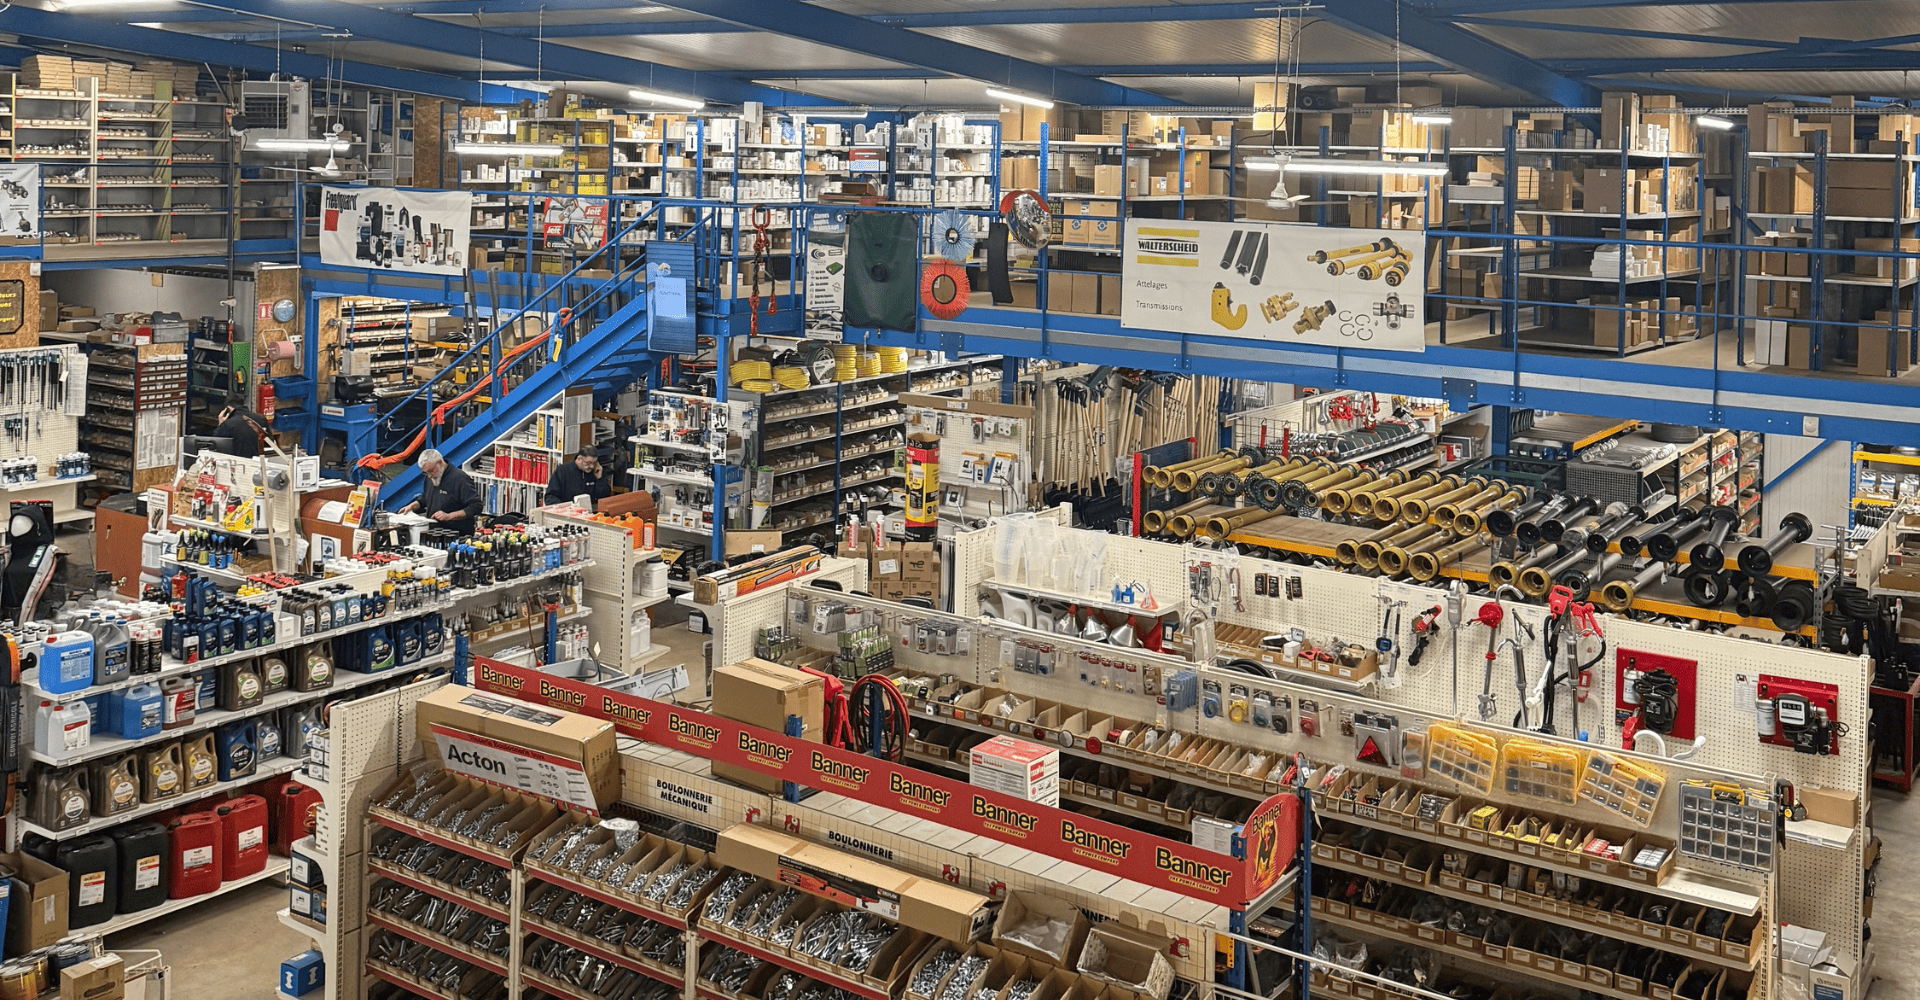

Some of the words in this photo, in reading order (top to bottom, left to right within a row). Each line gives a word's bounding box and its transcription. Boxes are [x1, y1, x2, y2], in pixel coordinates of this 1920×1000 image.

[1138, 240, 1199, 253] WALTERSCHEID
[1136, 280, 1168, 290] Attelages
[1136, 300, 1183, 312] Transmissions
[481, 664, 524, 690] Banner
[540, 680, 586, 706] Banner
[603, 696, 651, 724] Banner
[668, 713, 721, 742] Banner
[448, 744, 506, 775] Acton
[738, 731, 792, 762] Banner
[811, 751, 870, 784] Banner
[656, 779, 712, 804] BOULONNERIE
[660, 791, 708, 814] MÉCANIQUE
[890, 772, 950, 807] Banner
[972, 795, 1038, 832] Banner
[1252, 802, 1282, 835] Banner
[828, 830, 893, 860] BOULONNERIE
[1007, 828, 1026, 838] COMPANY
[1061, 819, 1130, 858] Banner
[1098, 854, 1118, 865] COMPANY
[1156, 846, 1231, 886] Banner
[1196, 883, 1218, 893] COMPANY
